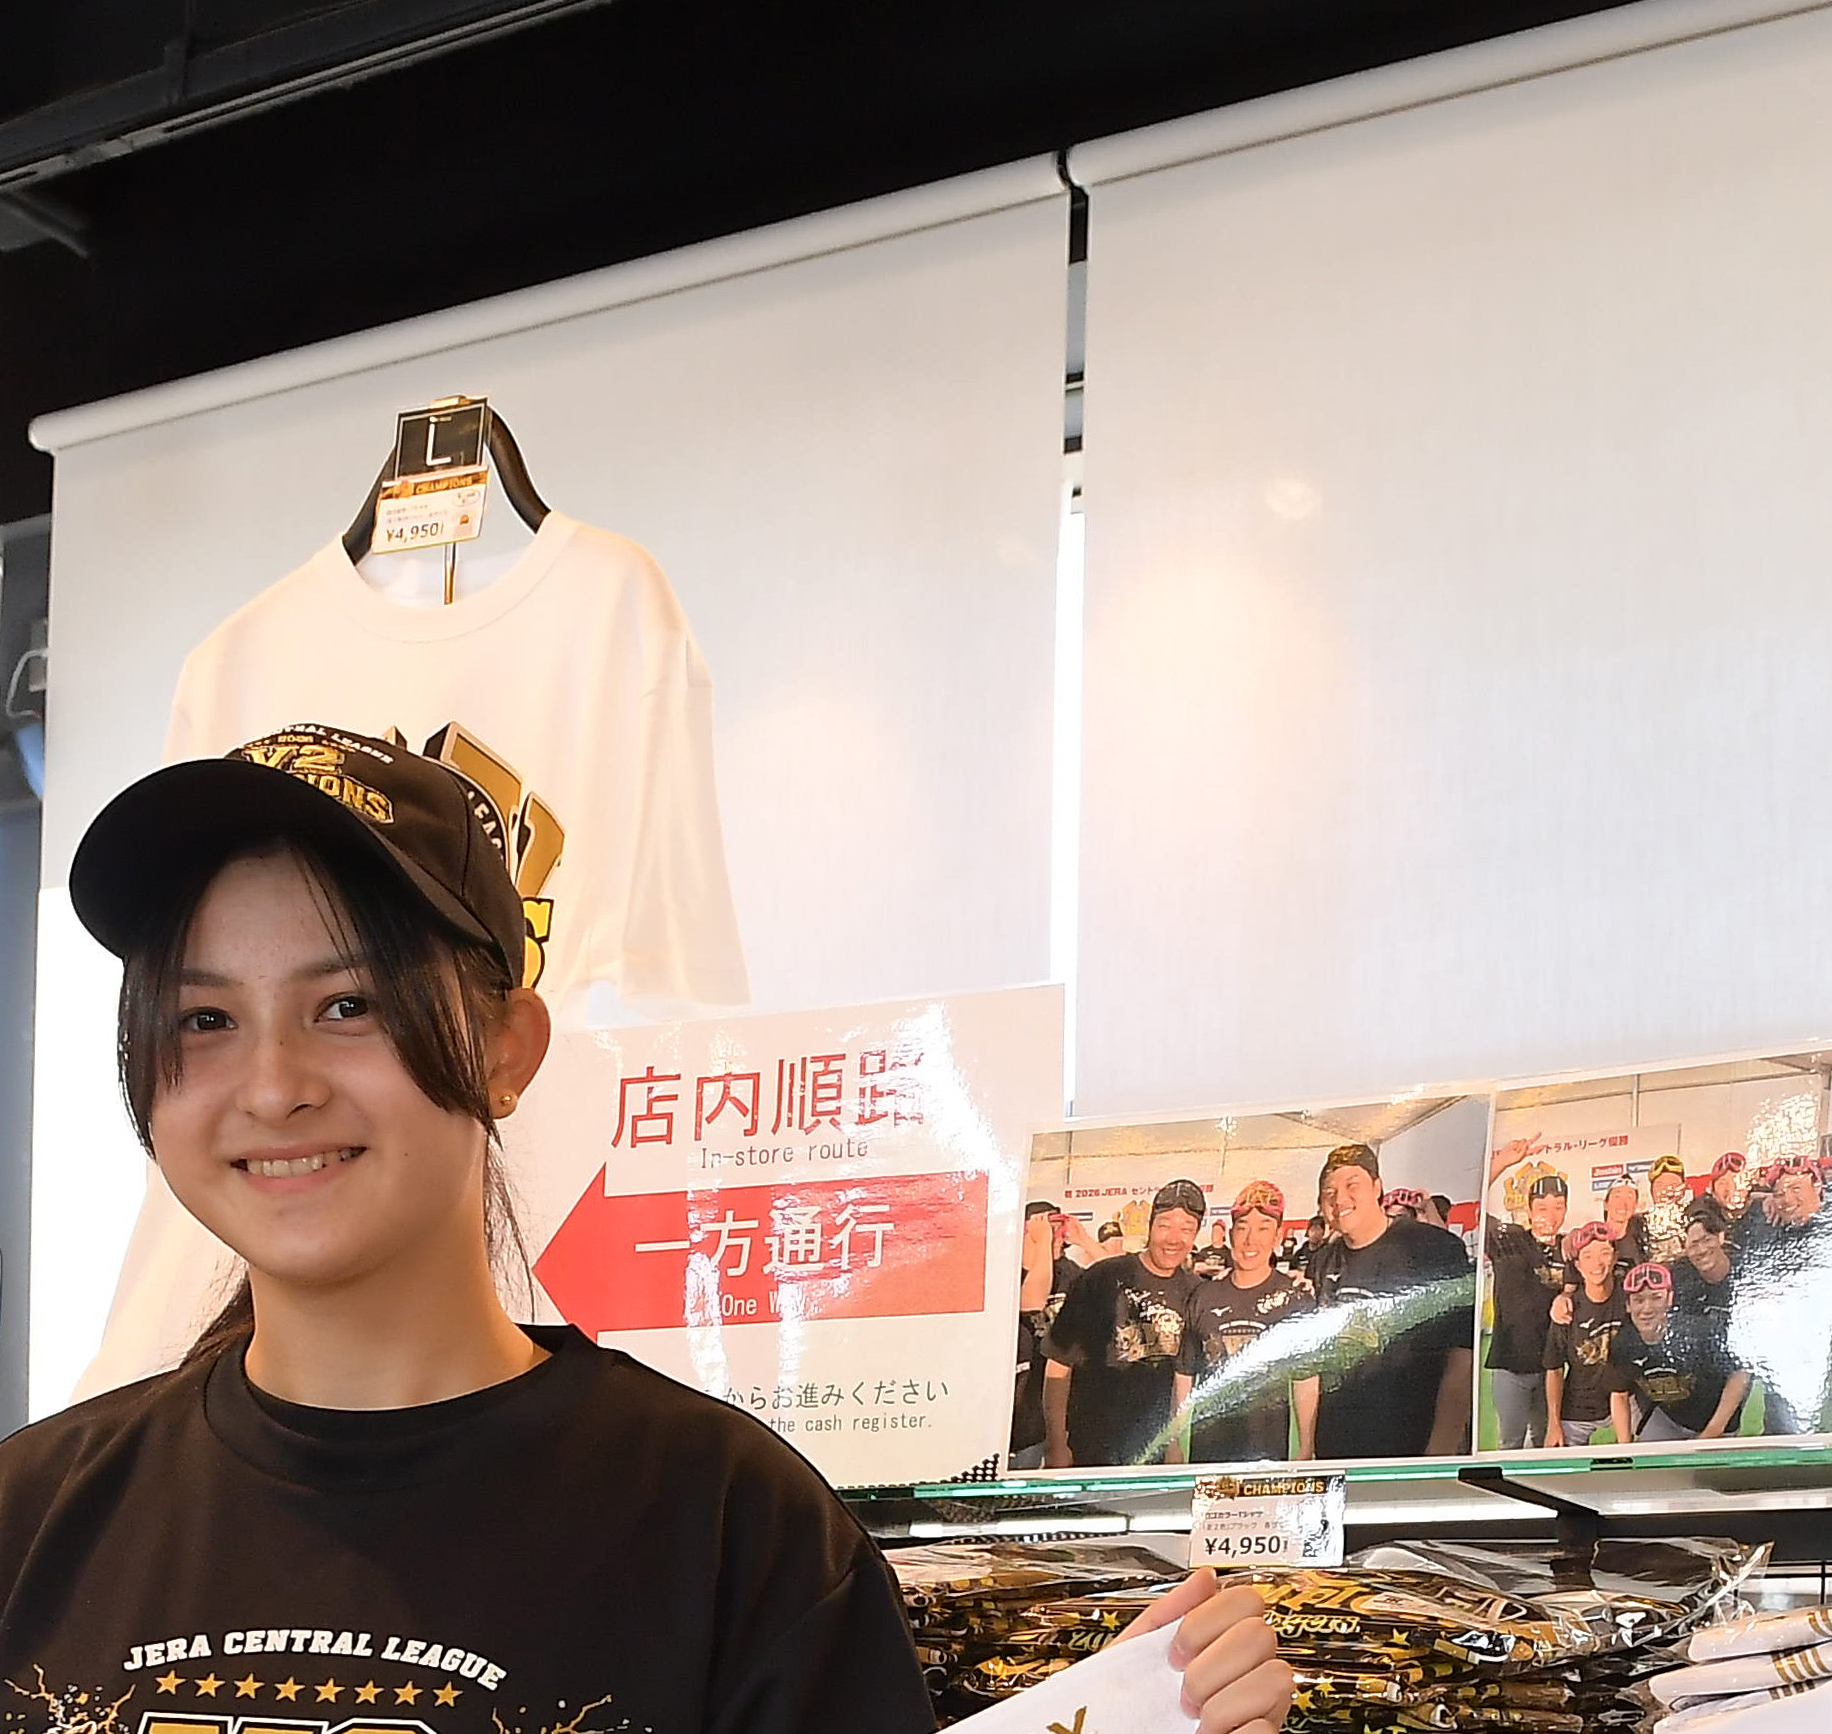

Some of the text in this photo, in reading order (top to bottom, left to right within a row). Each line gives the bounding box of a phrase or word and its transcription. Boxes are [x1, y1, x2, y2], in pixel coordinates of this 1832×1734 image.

[386, 522, 439, 543] ¥4,950
[611, 1049, 925, 1149] 店内順路
[700, 1136, 869, 1169] In-store route
[1101, 1187, 1127, 1198] JERA
[635, 1202, 895, 1278] 一方通行
[721, 1293, 757, 1317] One
[709, 1377, 949, 1411] からお進みください
[806, 1413, 842, 1433] cash
[852, 1410, 933, 1435] register.
[1243, 1480, 1325, 1496] CHAMPIONS
[1205, 1535, 1281, 1558] ¥4,950
[124, 1628, 509, 1691] JERA CENTRAL LEAGUE
